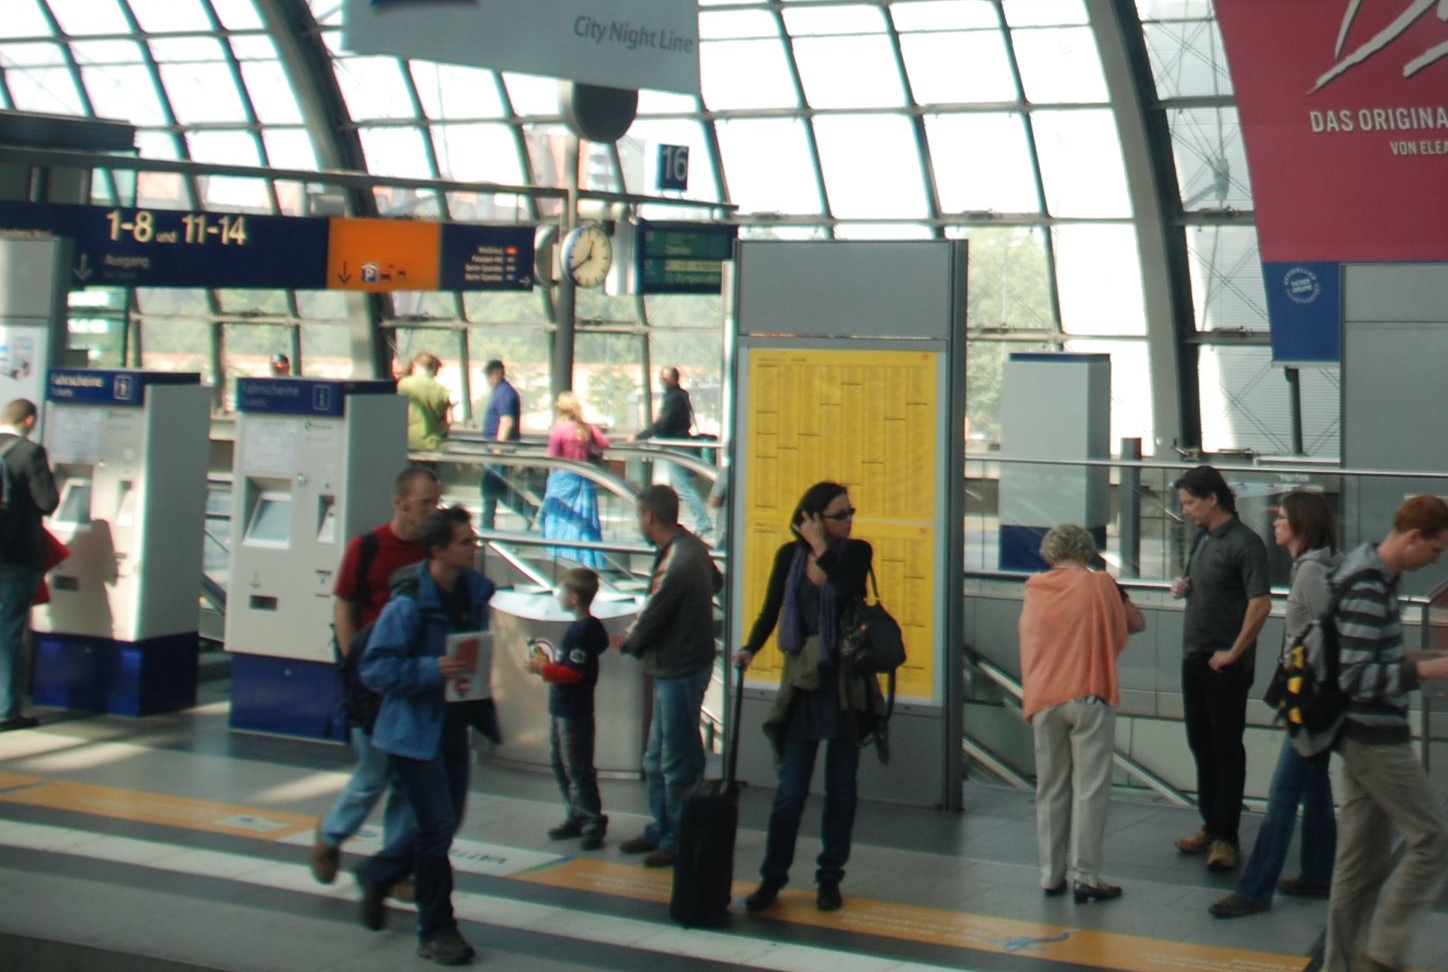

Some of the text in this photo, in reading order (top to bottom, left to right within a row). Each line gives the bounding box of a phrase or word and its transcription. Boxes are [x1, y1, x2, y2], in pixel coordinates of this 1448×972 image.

[574, 15, 694, 54] City Night Line
[1310, 110, 1354, 133] DAS
[661, 147, 687, 180] 16
[1390, 141, 1418, 156] VON
[106, 209, 247, 246] 1-8 und 11-14
